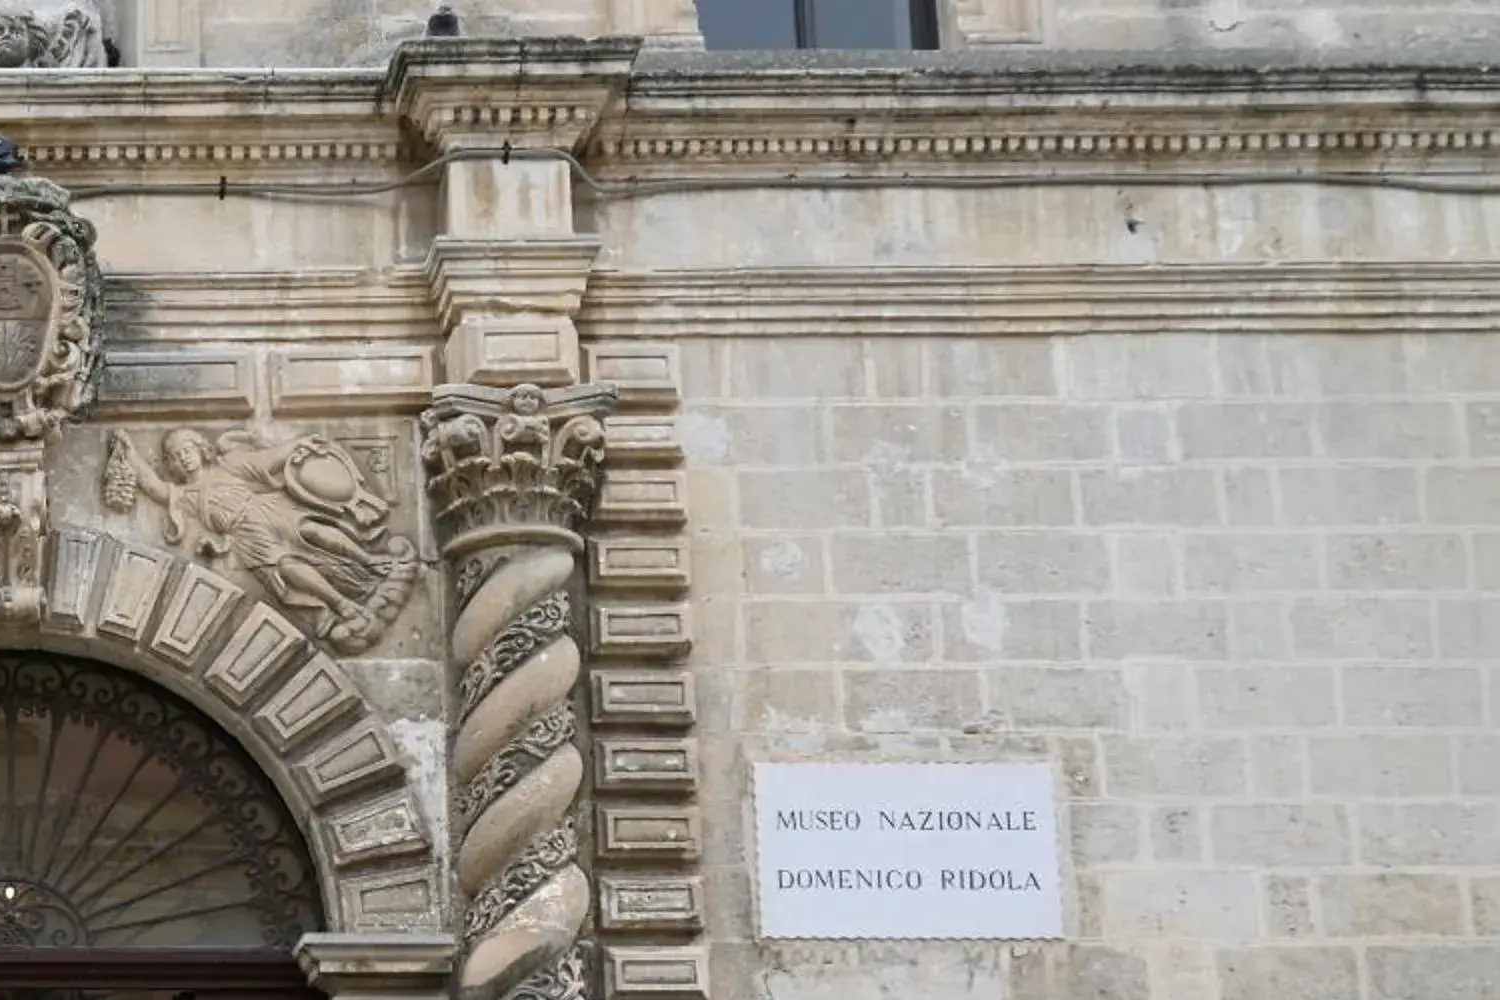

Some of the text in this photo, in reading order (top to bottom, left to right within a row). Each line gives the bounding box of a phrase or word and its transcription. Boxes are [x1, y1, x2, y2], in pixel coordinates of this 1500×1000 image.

[776, 810, 1037, 831] MUSEO NAZIONALE
[777, 869, 1042, 891] DOMENICO RIDOLA
